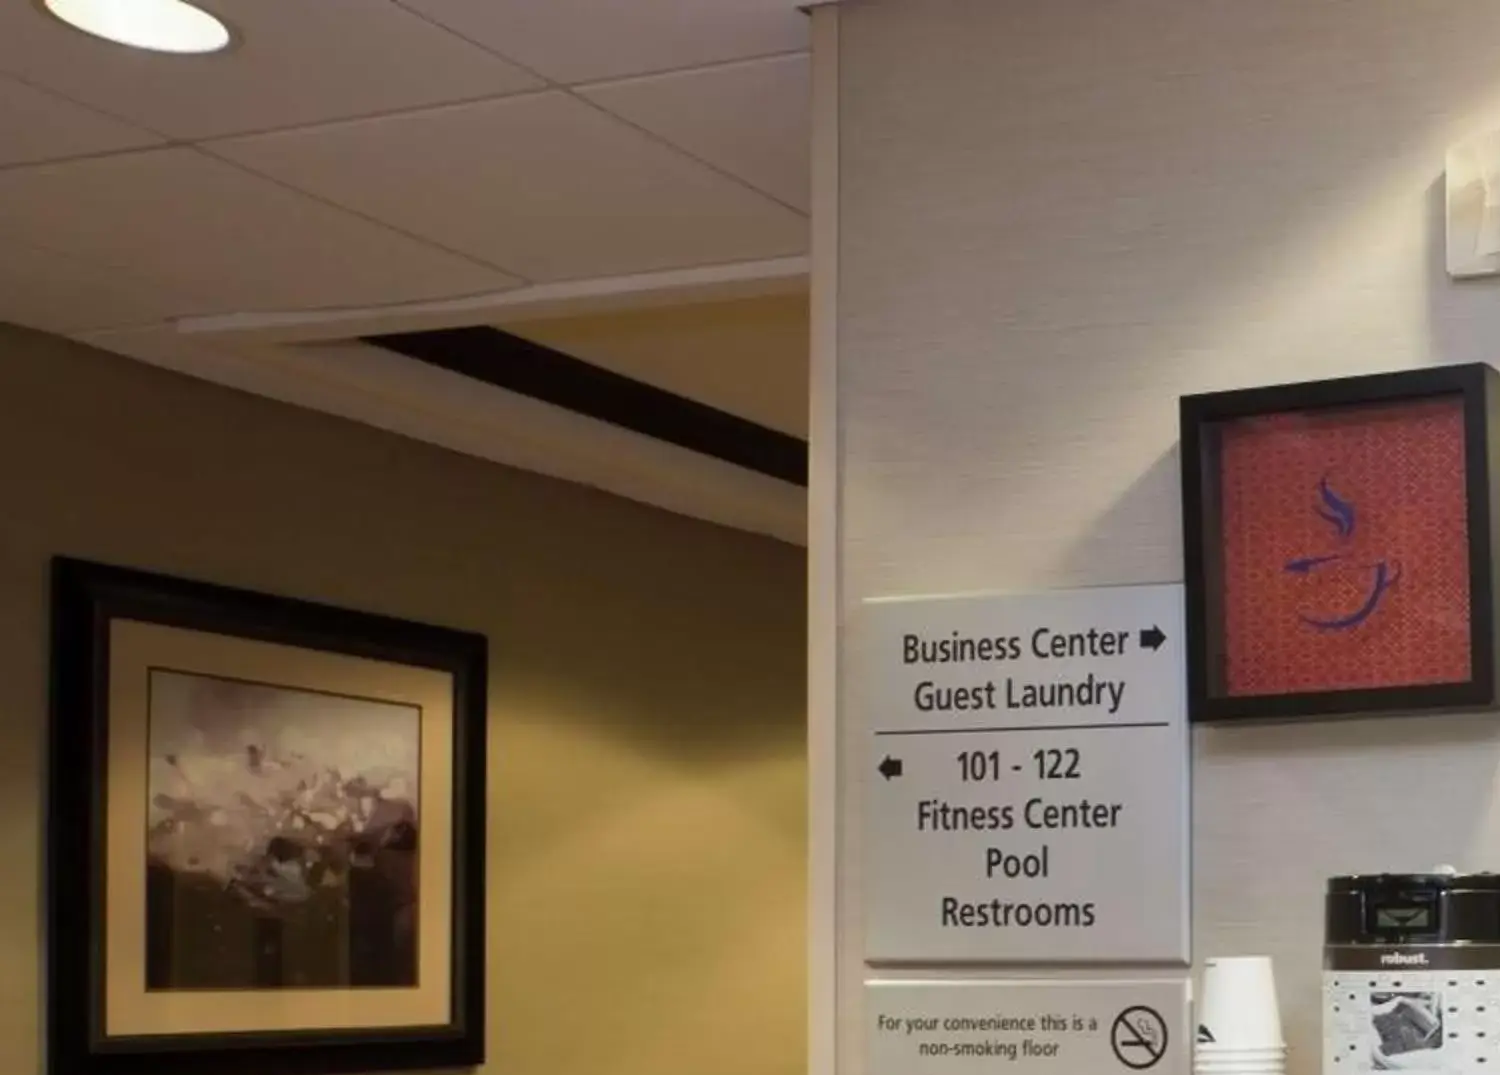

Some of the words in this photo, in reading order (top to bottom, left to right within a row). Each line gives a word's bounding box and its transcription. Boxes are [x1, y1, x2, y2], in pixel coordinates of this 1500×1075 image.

[903, 631, 1021, 664] Business
[1031, 628, 1130, 657] Center
[914, 681, 996, 711] Guest
[1006, 673, 1126, 713] Laundry
[957, 751, 1000, 781] 101
[1033, 748, 1081, 779] 122
[917, 799, 1014, 831] Fitness
[1024, 798, 1123, 828] Center
[986, 845, 1048, 878] Pool
[941, 896, 1096, 927] Restrooms
[1380, 952, 1429, 965] robust.
[878, 1015, 901, 1030] For
[906, 1016, 939, 1034] your
[943, 1014, 1036, 1031] convenience
[1041, 1014, 1067, 1031] this
[1072, 1014, 1084, 1031] is
[1088, 1018, 1098, 1031] a
[919, 1039, 1017, 1060] non-smoking
[1022, 1038, 1059, 1057] floor
